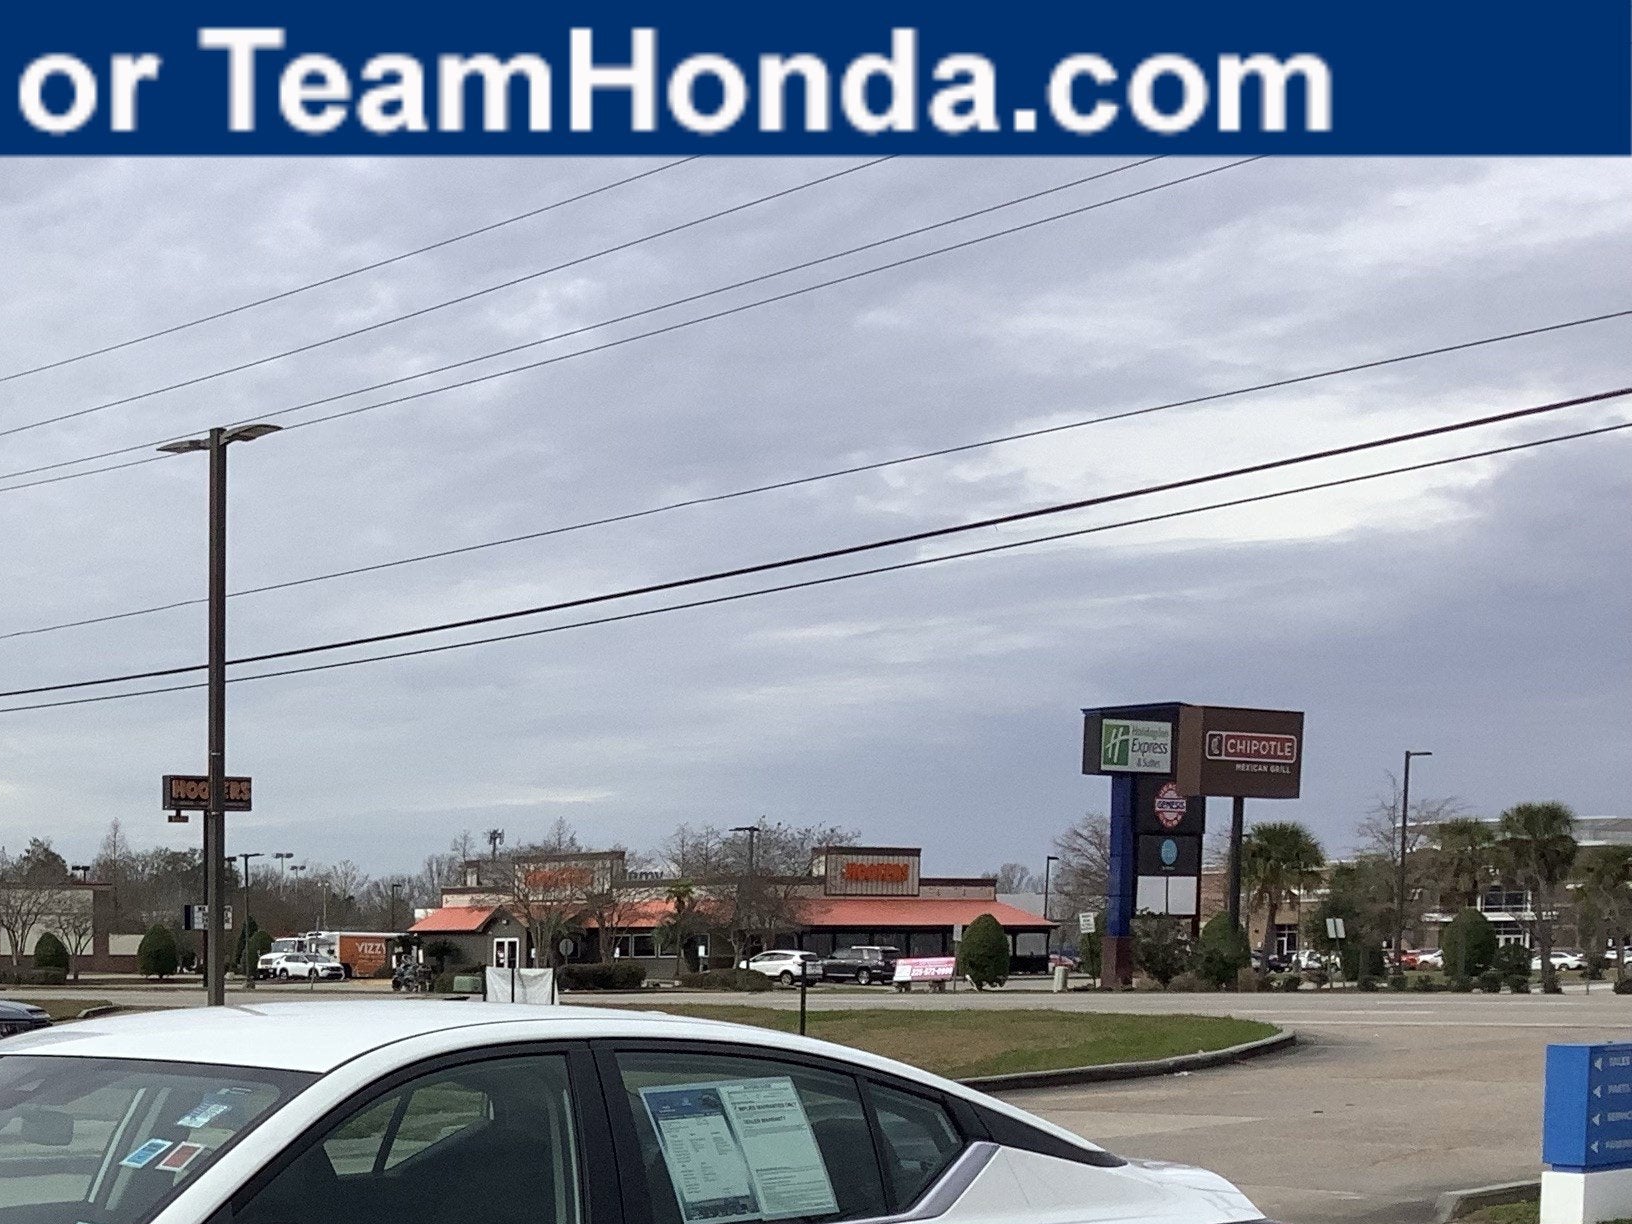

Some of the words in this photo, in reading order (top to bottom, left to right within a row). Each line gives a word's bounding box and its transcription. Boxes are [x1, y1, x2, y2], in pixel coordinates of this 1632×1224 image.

[1131, 738, 1168, 757] Express
[1227, 739, 1292, 756] CHIPOTLE
[1235, 763, 1268, 772] MEXICAN
[1269, 765, 1291, 774] GRILL
[172, 779, 250, 800] HOOERS
